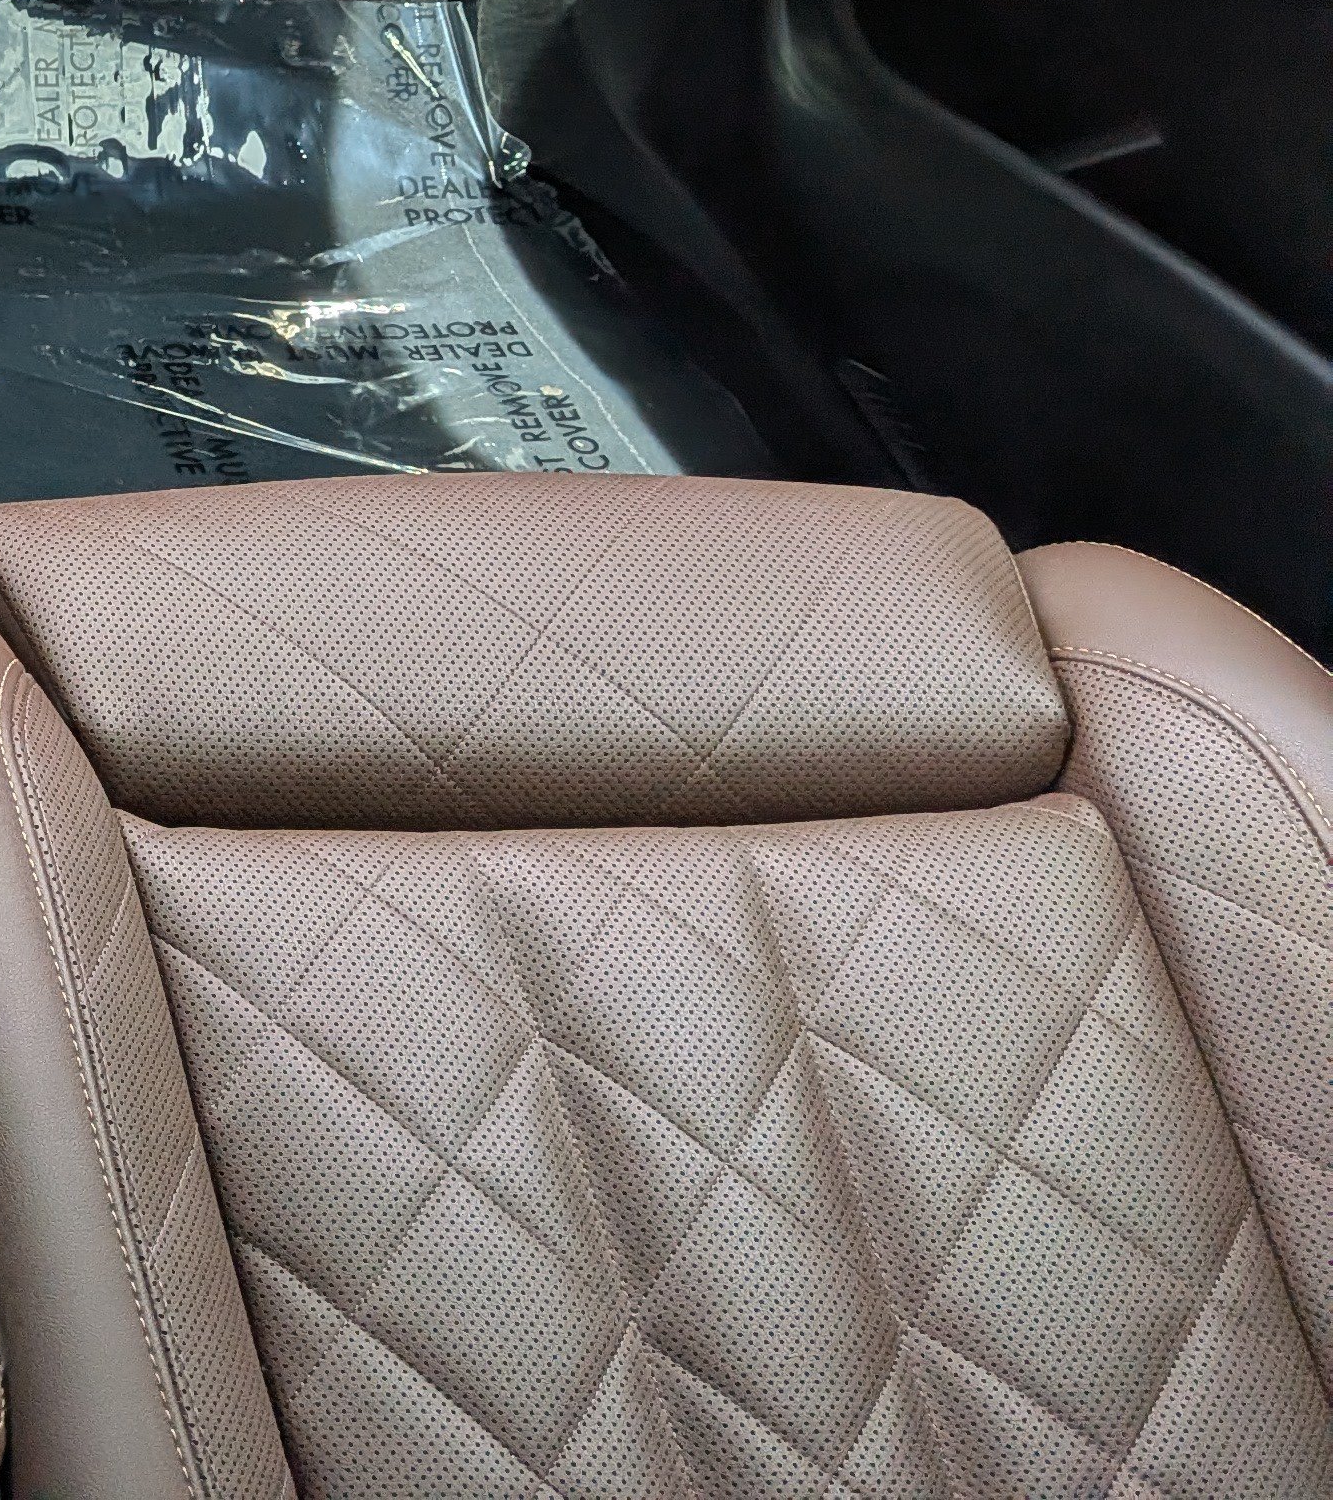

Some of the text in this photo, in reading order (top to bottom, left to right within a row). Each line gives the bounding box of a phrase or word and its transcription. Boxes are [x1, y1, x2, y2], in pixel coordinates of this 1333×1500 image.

[403, 341, 533, 361] DEALER
[472, 362, 552, 442] REMOVE
[540, 394, 610, 471] COVER
